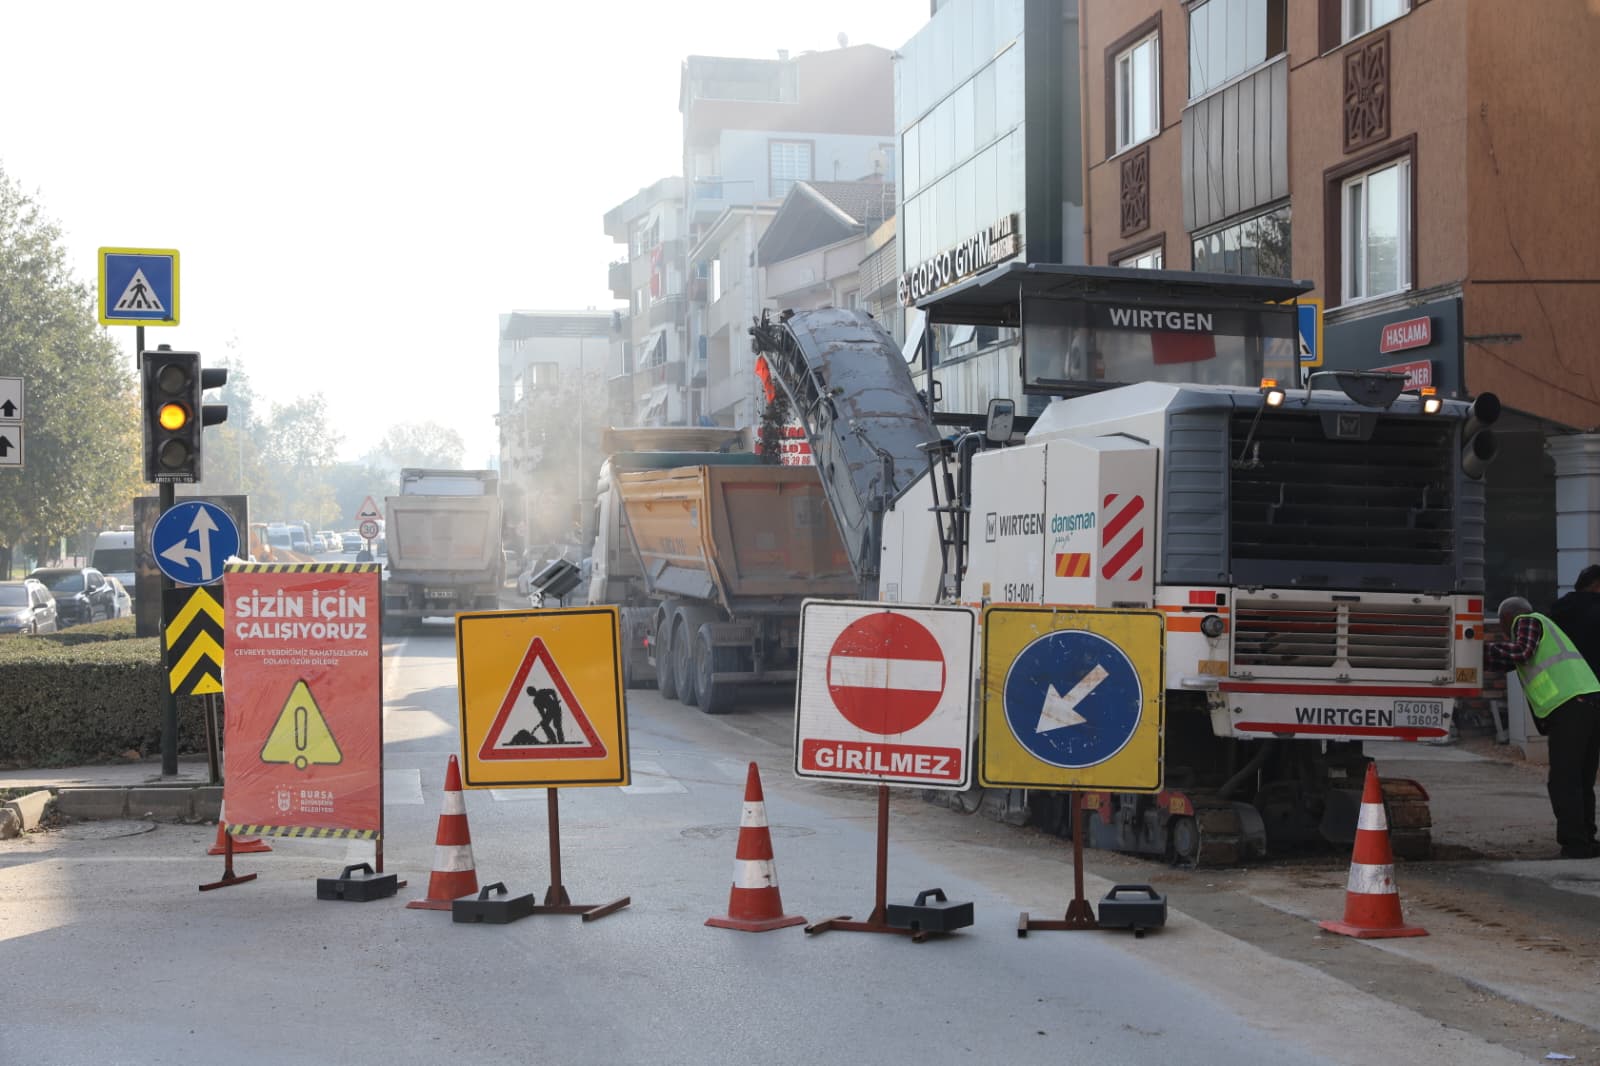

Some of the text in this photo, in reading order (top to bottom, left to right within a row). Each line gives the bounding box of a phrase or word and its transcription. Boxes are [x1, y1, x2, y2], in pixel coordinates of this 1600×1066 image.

[911, 250, 951, 299] GOPSO
[1109, 307, 1213, 331] WIRTGEN
[1386, 324, 1428, 349] HAŞLAMA
[999, 513, 1045, 537] WIRTGEN
[1004, 583, 1035, 603] 151-001
[235, 588, 366, 621] SİZİN İÇİN
[235, 622, 367, 641] ÇALIŞIYORUZ
[1295, 706, 1393, 727] WIRTGEN
[1397, 703, 1411, 715] 34
[1406, 715, 1440, 726] 13602
[814, 743, 951, 776] GİRİLMEZ
[300, 790, 334, 800] BURSA
